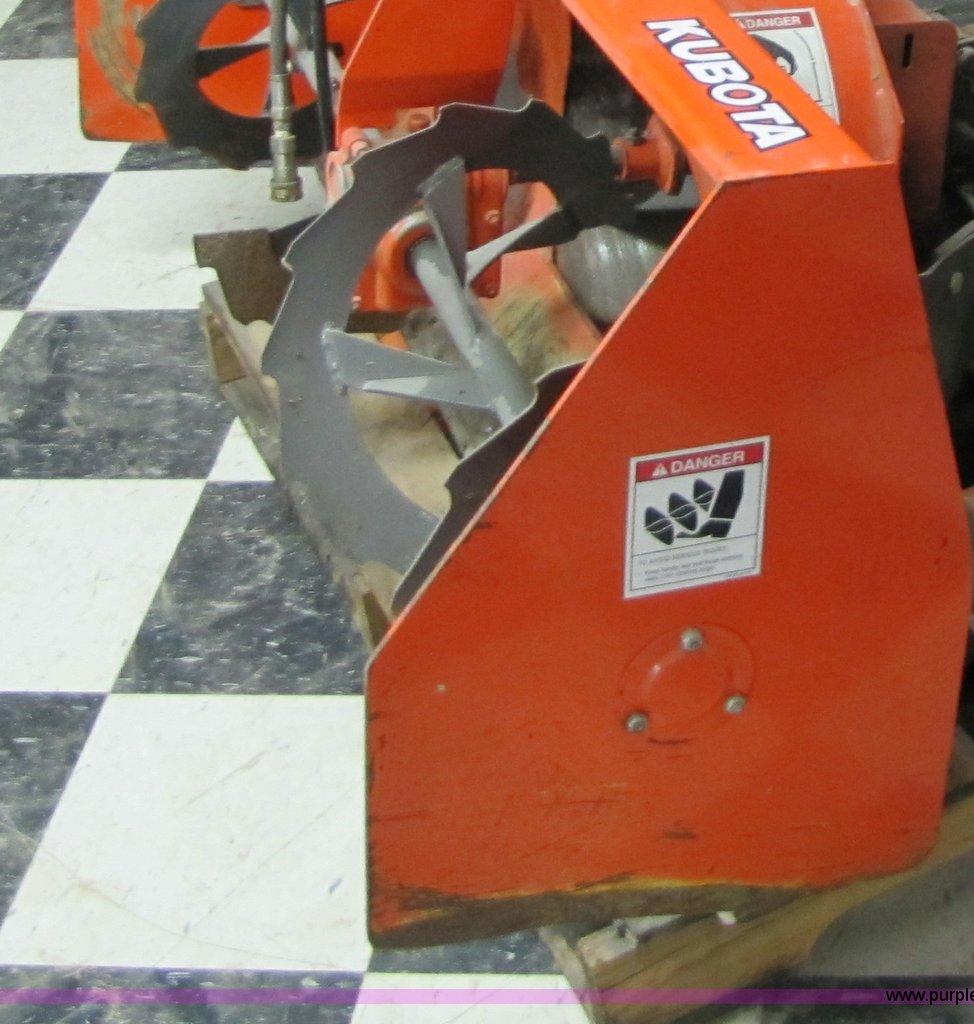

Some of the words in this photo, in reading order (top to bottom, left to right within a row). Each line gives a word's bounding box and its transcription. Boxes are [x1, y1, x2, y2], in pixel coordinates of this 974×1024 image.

[745, 15, 802, 29] DANGER
[642, 17, 812, 152] KUBOTA
[670, 449, 746, 475] DANGER
